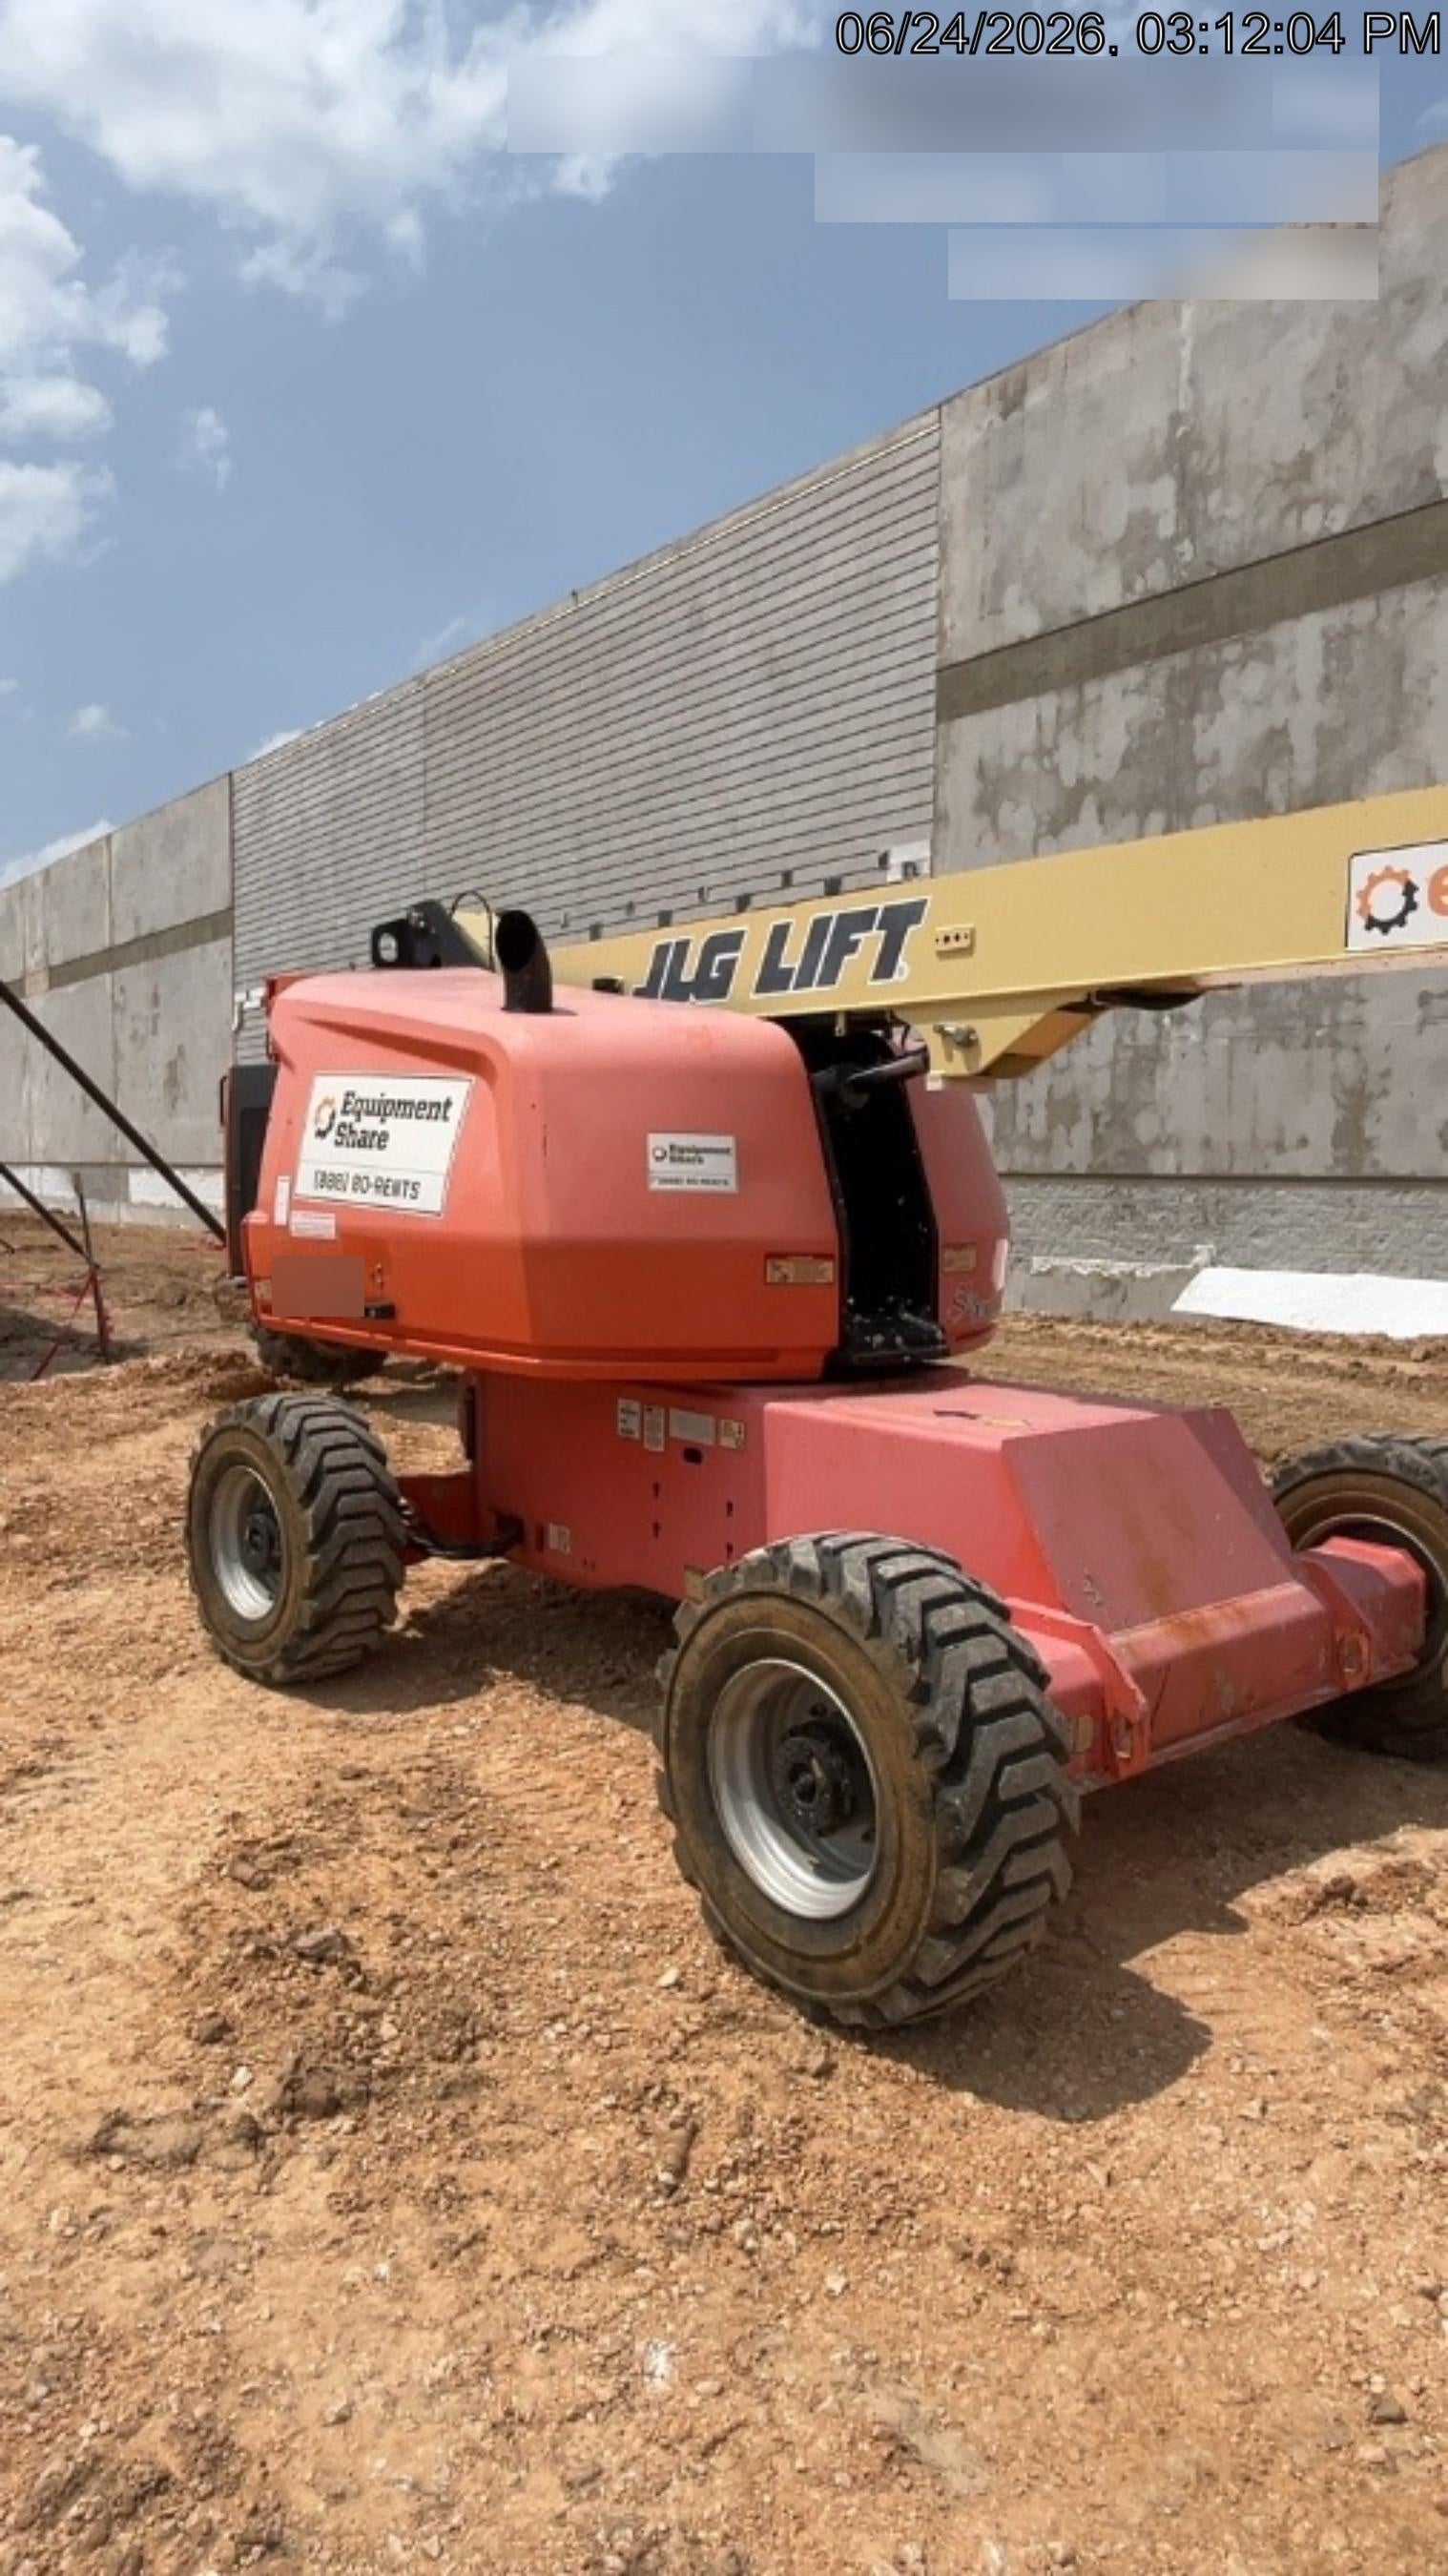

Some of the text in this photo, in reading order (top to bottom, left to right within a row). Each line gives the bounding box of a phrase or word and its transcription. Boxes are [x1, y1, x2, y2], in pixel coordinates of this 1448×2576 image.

[631, 898, 929, 1002] JLG LIFT
[341, 1091, 452, 1123] Equipment
[334, 1121, 389, 1151] Share
